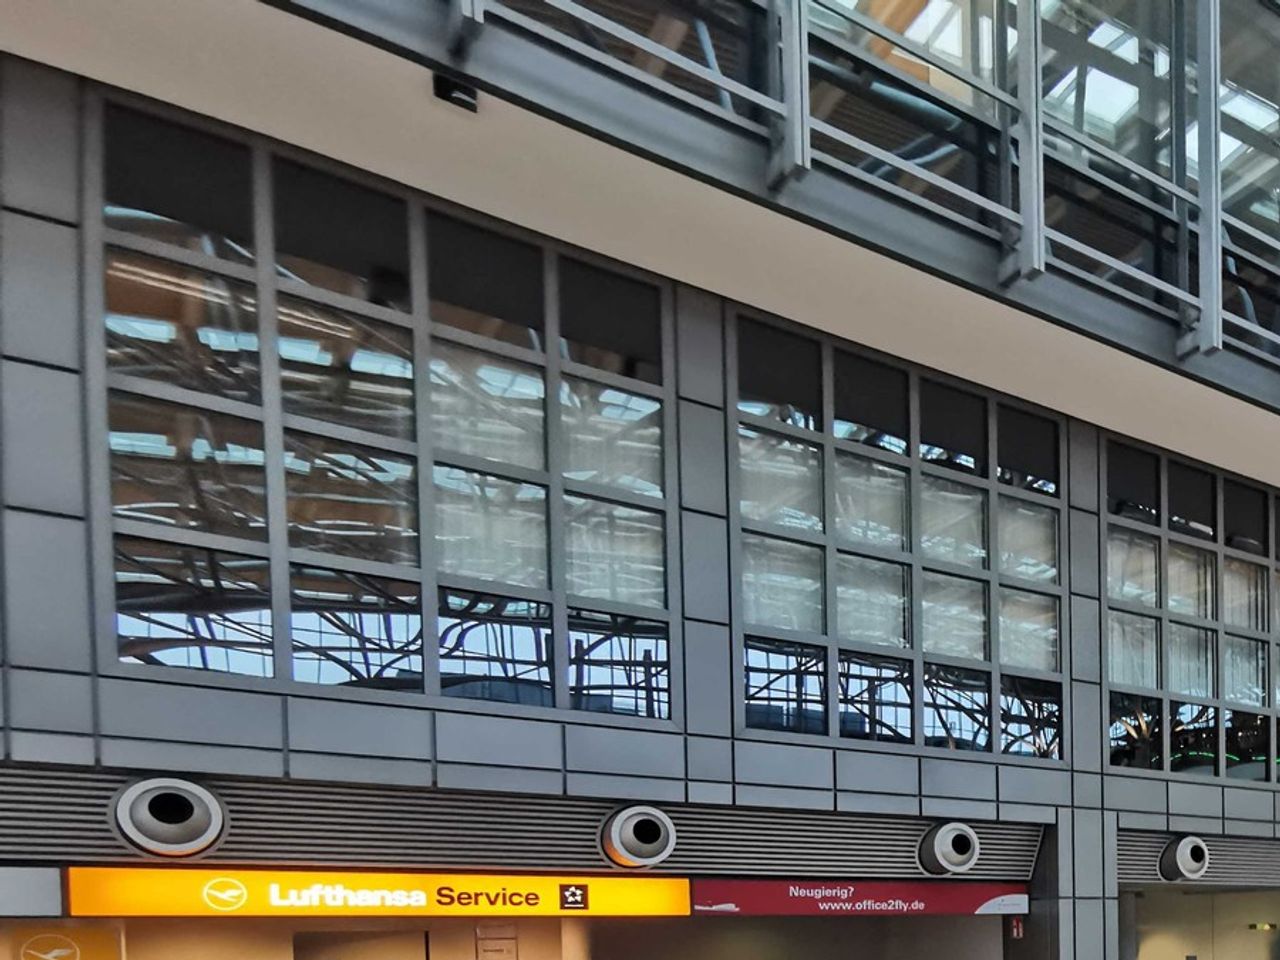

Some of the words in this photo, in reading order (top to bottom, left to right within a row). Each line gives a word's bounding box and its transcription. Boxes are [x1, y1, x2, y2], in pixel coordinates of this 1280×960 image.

[268, 883, 427, 907] Lufthansa
[436, 886, 540, 907] Service
[789, 886, 855, 898] Neugierig?
[818, 900, 925, 911] www.office2fly.de
